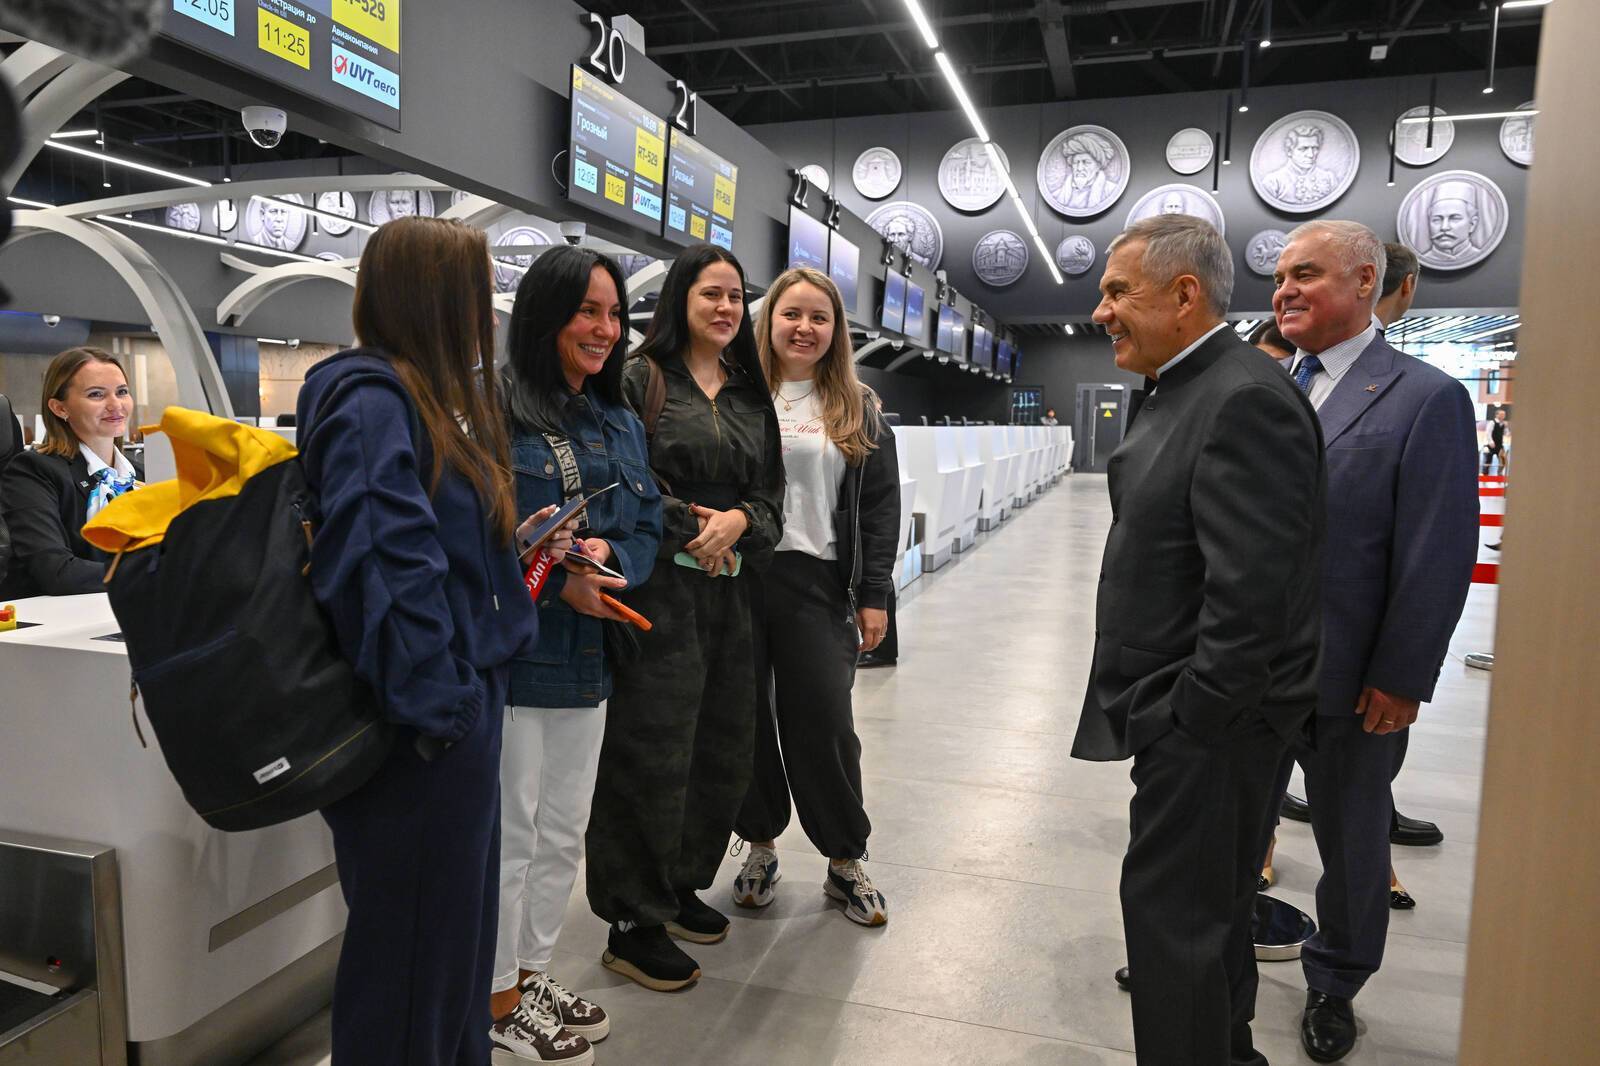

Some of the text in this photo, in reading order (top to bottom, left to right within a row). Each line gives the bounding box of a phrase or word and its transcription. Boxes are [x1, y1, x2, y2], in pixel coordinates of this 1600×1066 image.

[306, 14, 316, 24] до
[264, 22, 306, 57] 11:25
[331, 24, 379, 55] Авиакомпания
[590, 12, 626, 84] 20
[349, 62, 374, 85] UVT
[676, 80, 697, 135] 21
[577, 111, 608, 141] Грозный
[638, 145, 658, 167] RT-529
[794, 168, 809, 209] 22
